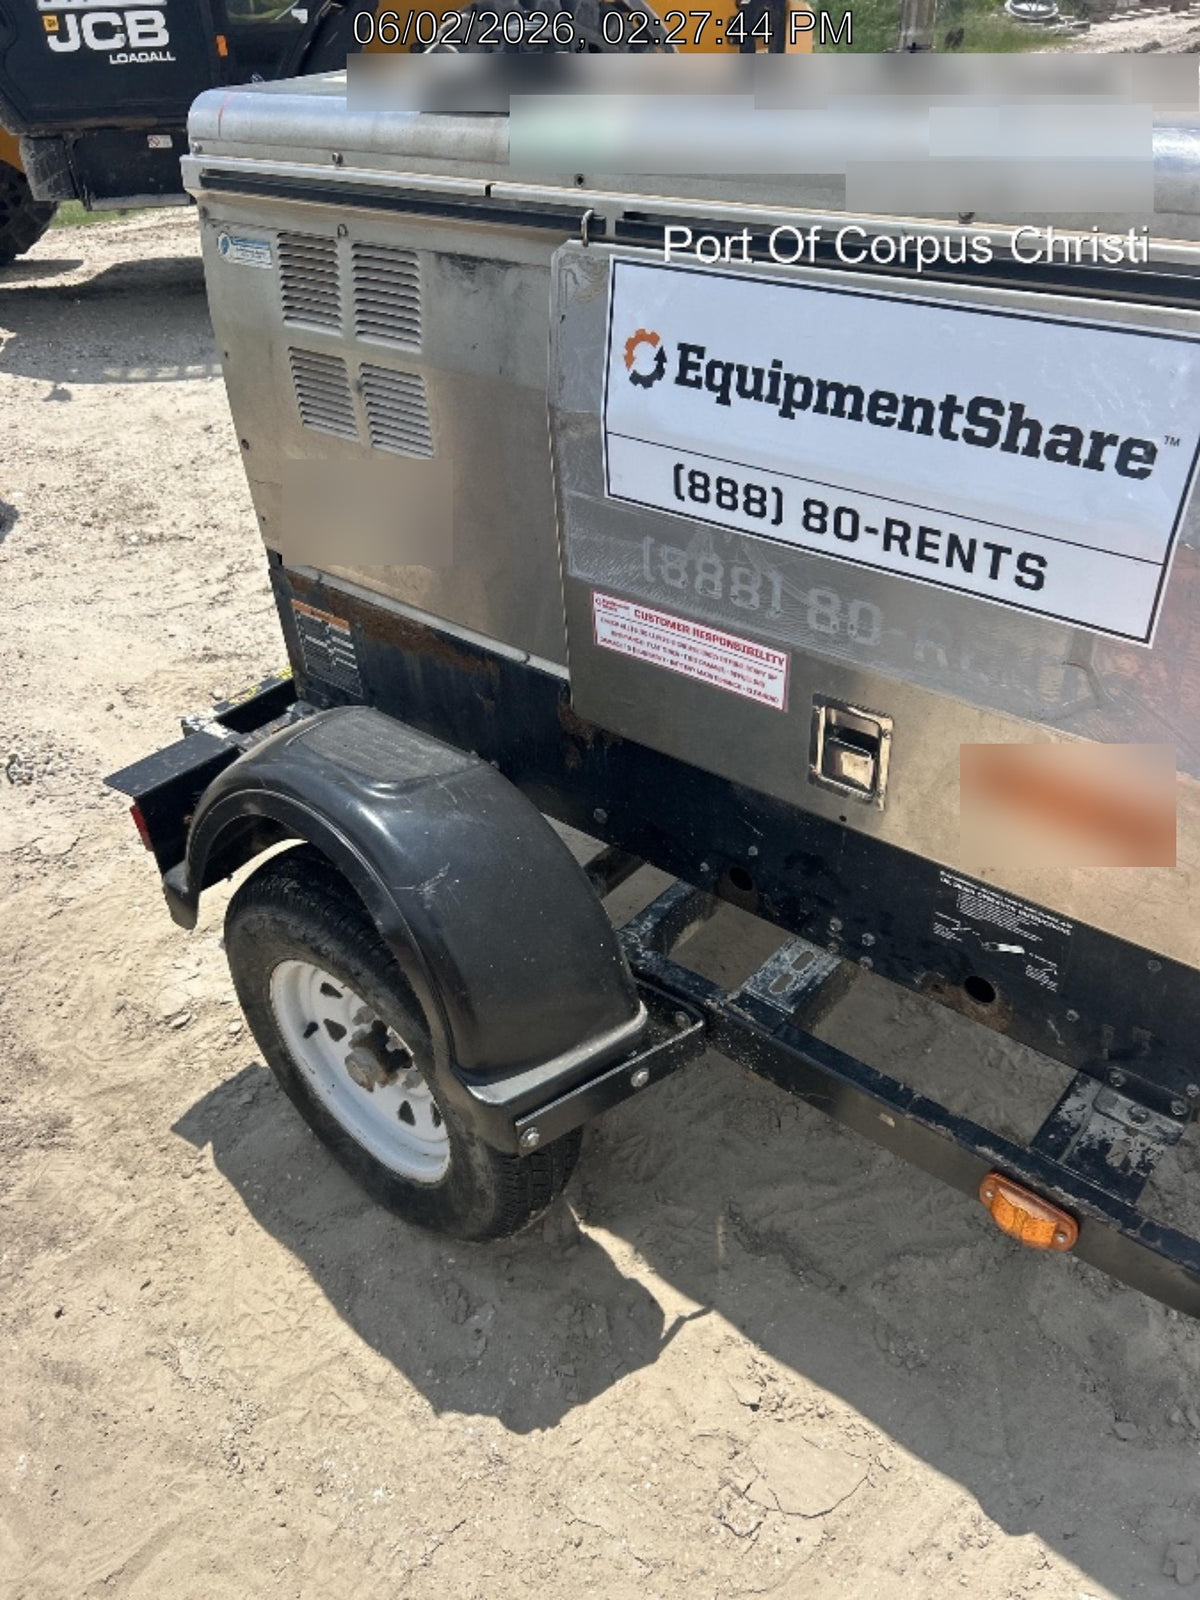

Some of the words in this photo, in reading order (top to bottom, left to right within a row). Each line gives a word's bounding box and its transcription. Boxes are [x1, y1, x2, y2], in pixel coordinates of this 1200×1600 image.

[46, 10, 170, 52] JCB
[109, 51, 176, 65] LOADALL
[674, 341, 1159, 481] EquipmentShare
[672, 463, 784, 526] (888)
[802, 498, 1048, 592] 80-RENTS
[633, 609, 690, 634] CUSTOMER
